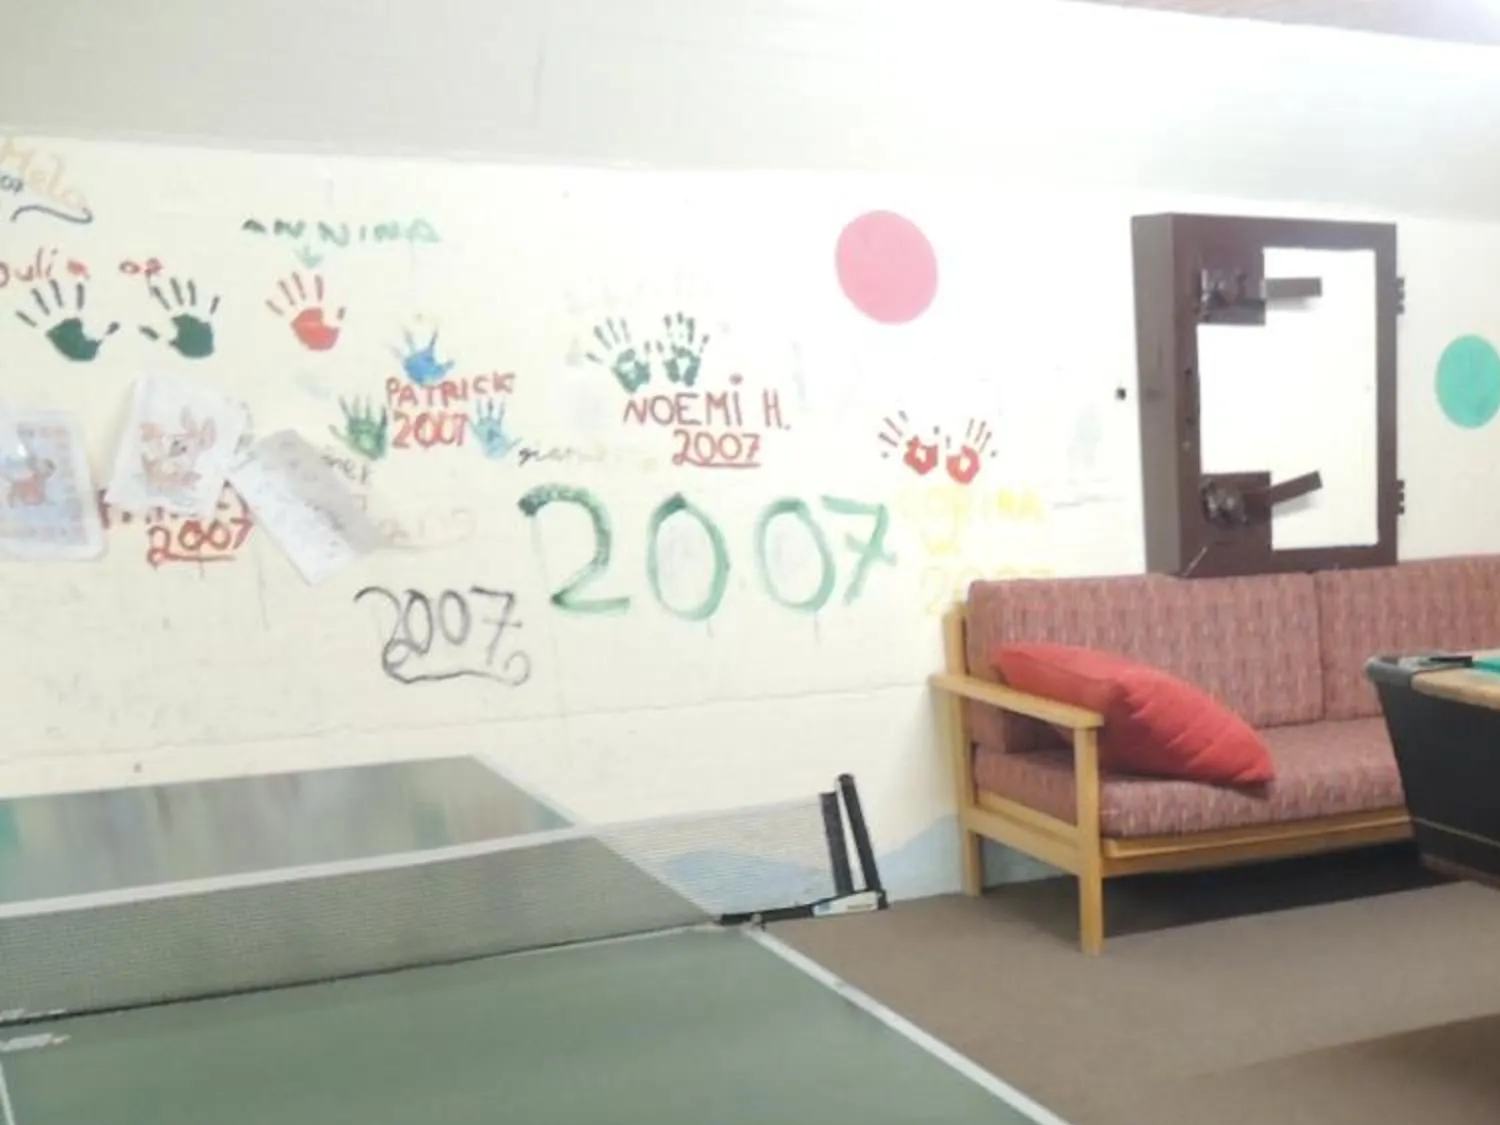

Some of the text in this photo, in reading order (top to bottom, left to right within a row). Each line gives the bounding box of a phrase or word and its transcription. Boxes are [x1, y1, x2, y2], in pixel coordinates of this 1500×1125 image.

[241, 217, 441, 247] ANNINA
[385, 370, 516, 407] PATRICK
[391, 410, 470, 449] 2007
[671, 428, 761, 469] 2007
[146, 518, 254, 571] 2007
[517, 483, 898, 622] 2007
[352, 585, 532, 686] 2007
